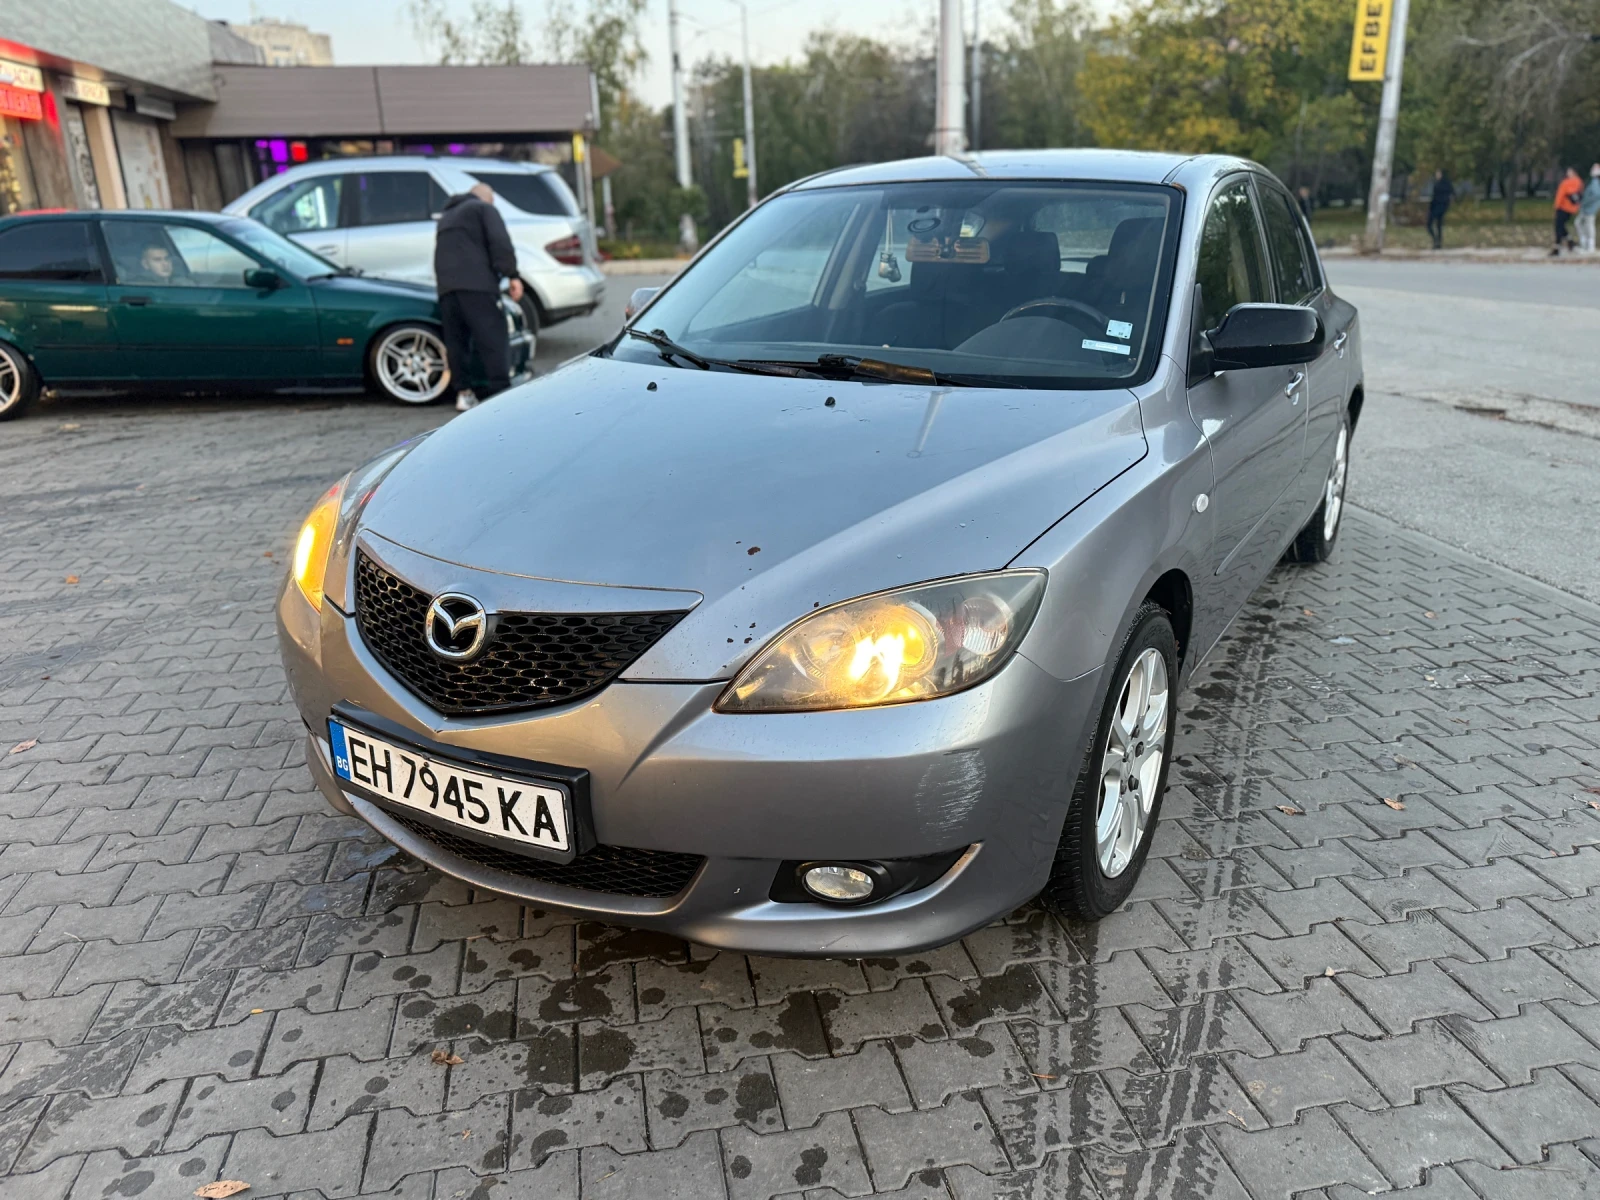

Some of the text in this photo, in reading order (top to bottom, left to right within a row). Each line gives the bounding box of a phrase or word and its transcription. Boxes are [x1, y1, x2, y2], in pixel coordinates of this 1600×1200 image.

[336, 755, 349, 772] BG
[348, 735, 560, 843] EH 7945 KA
